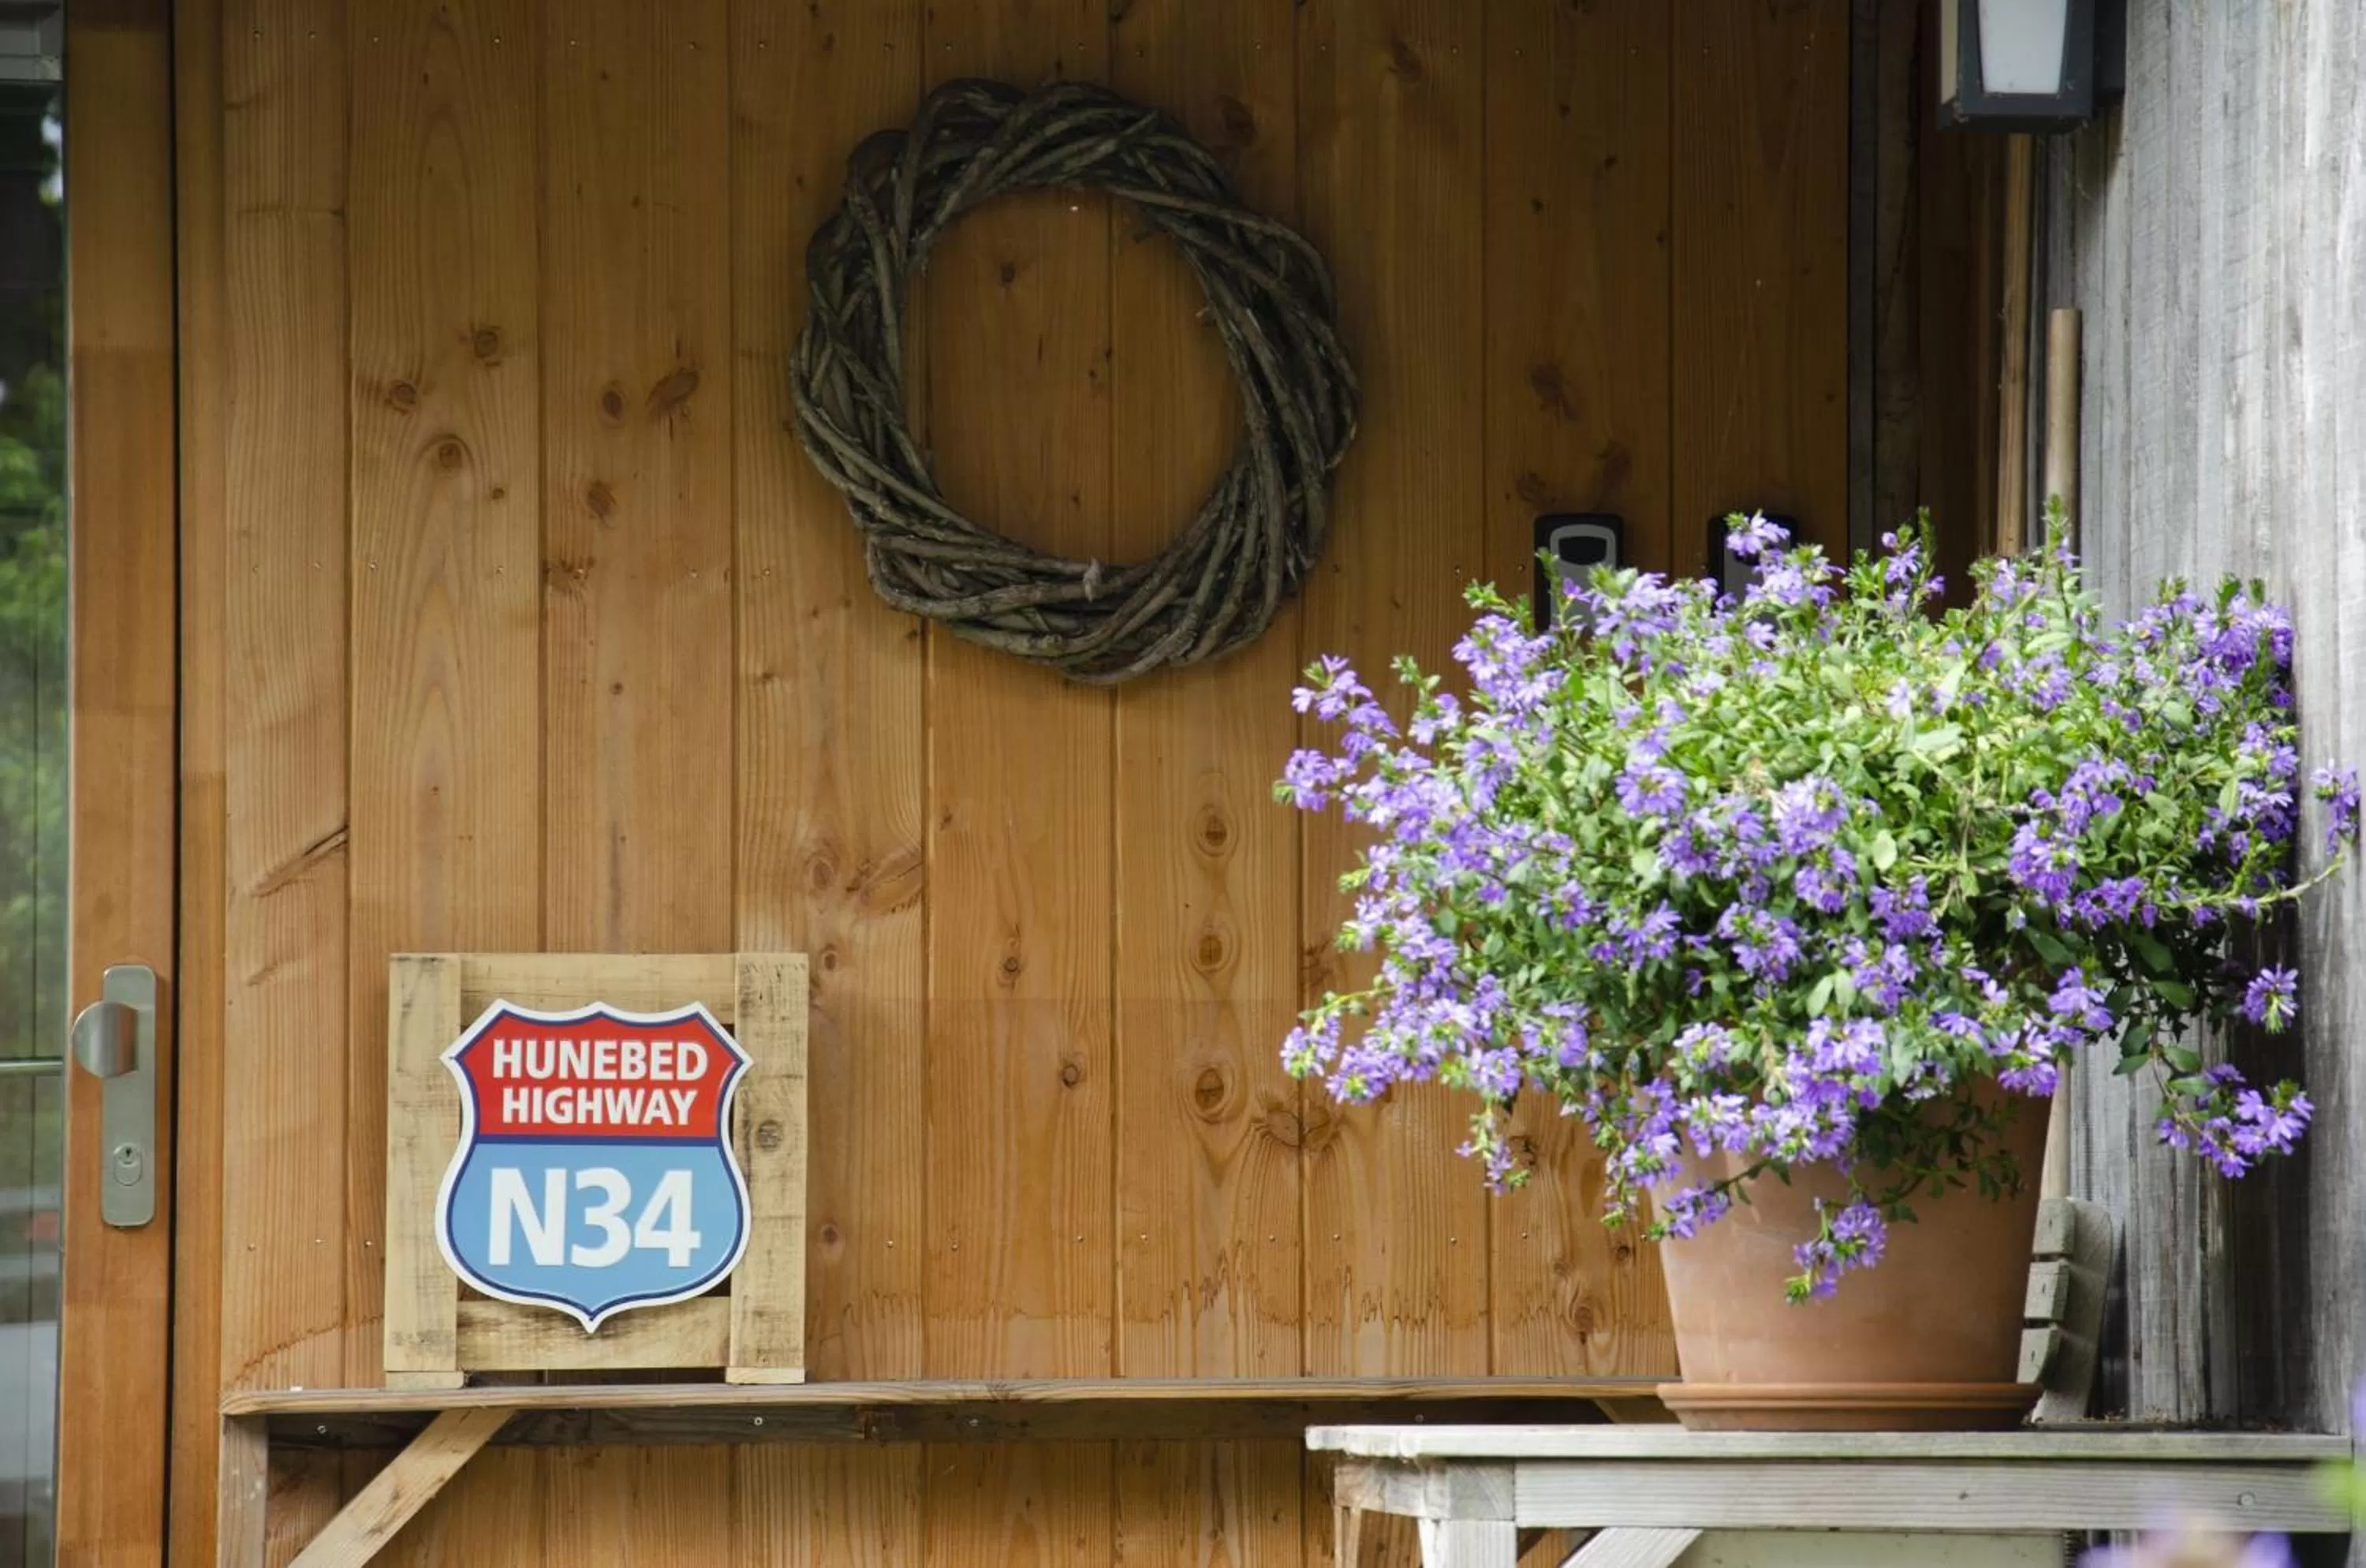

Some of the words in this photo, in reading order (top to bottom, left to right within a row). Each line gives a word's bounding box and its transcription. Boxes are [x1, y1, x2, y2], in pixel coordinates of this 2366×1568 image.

[493, 1040, 708, 1080] HUNEBED
[502, 1088, 697, 1125] HIGHWAY
[489, 1167, 701, 1267] N34
